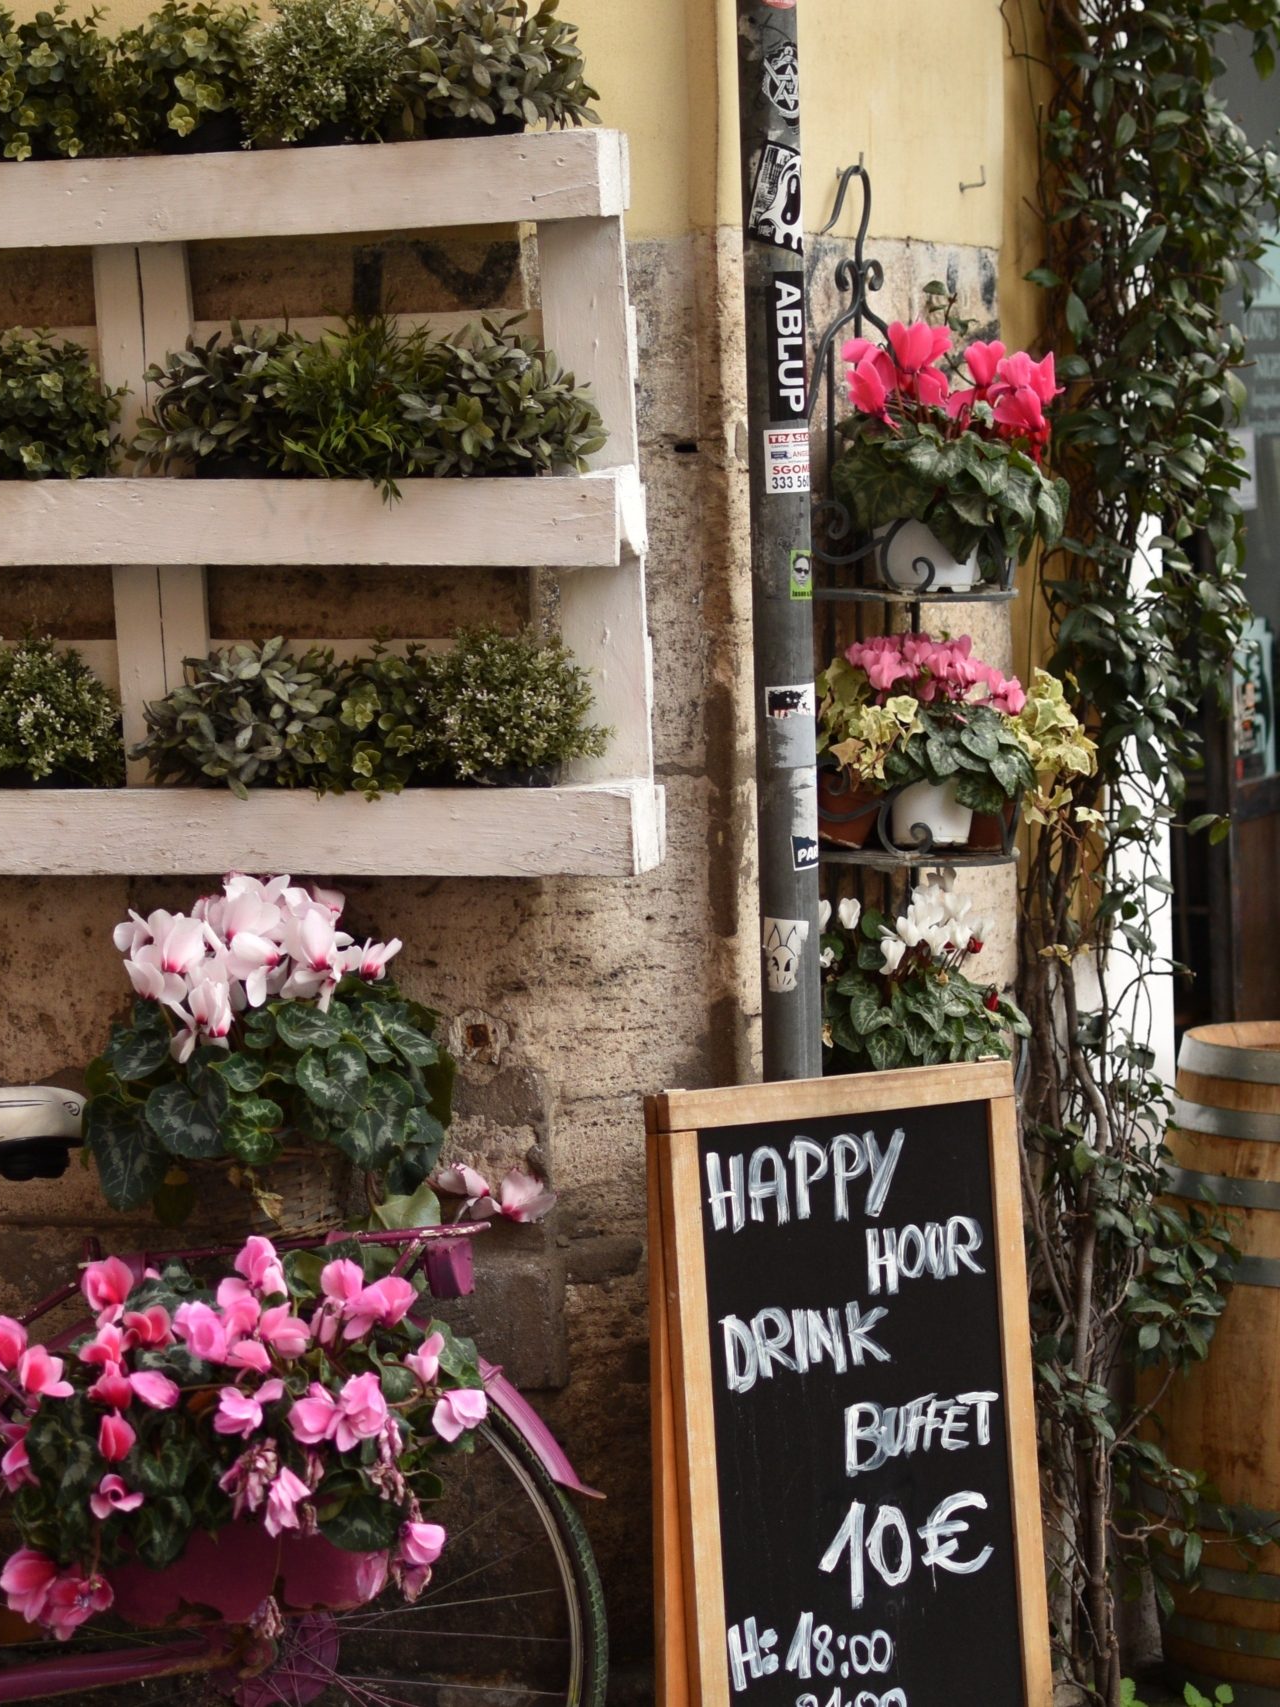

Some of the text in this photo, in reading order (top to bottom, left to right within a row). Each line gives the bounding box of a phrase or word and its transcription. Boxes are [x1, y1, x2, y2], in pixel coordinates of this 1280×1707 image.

[775, 280, 805, 412] ABLUP
[772, 476, 793, 490] 333
[706, 1128, 905, 1233] HAPPY
[866, 1215, 986, 1295] HOUR
[719, 1301, 892, 1393] DRINK
[844, 1391, 999, 1477] BUFFET
[819, 1490, 994, 1609] 10€
[785, 1612, 895, 1679] 18:00
